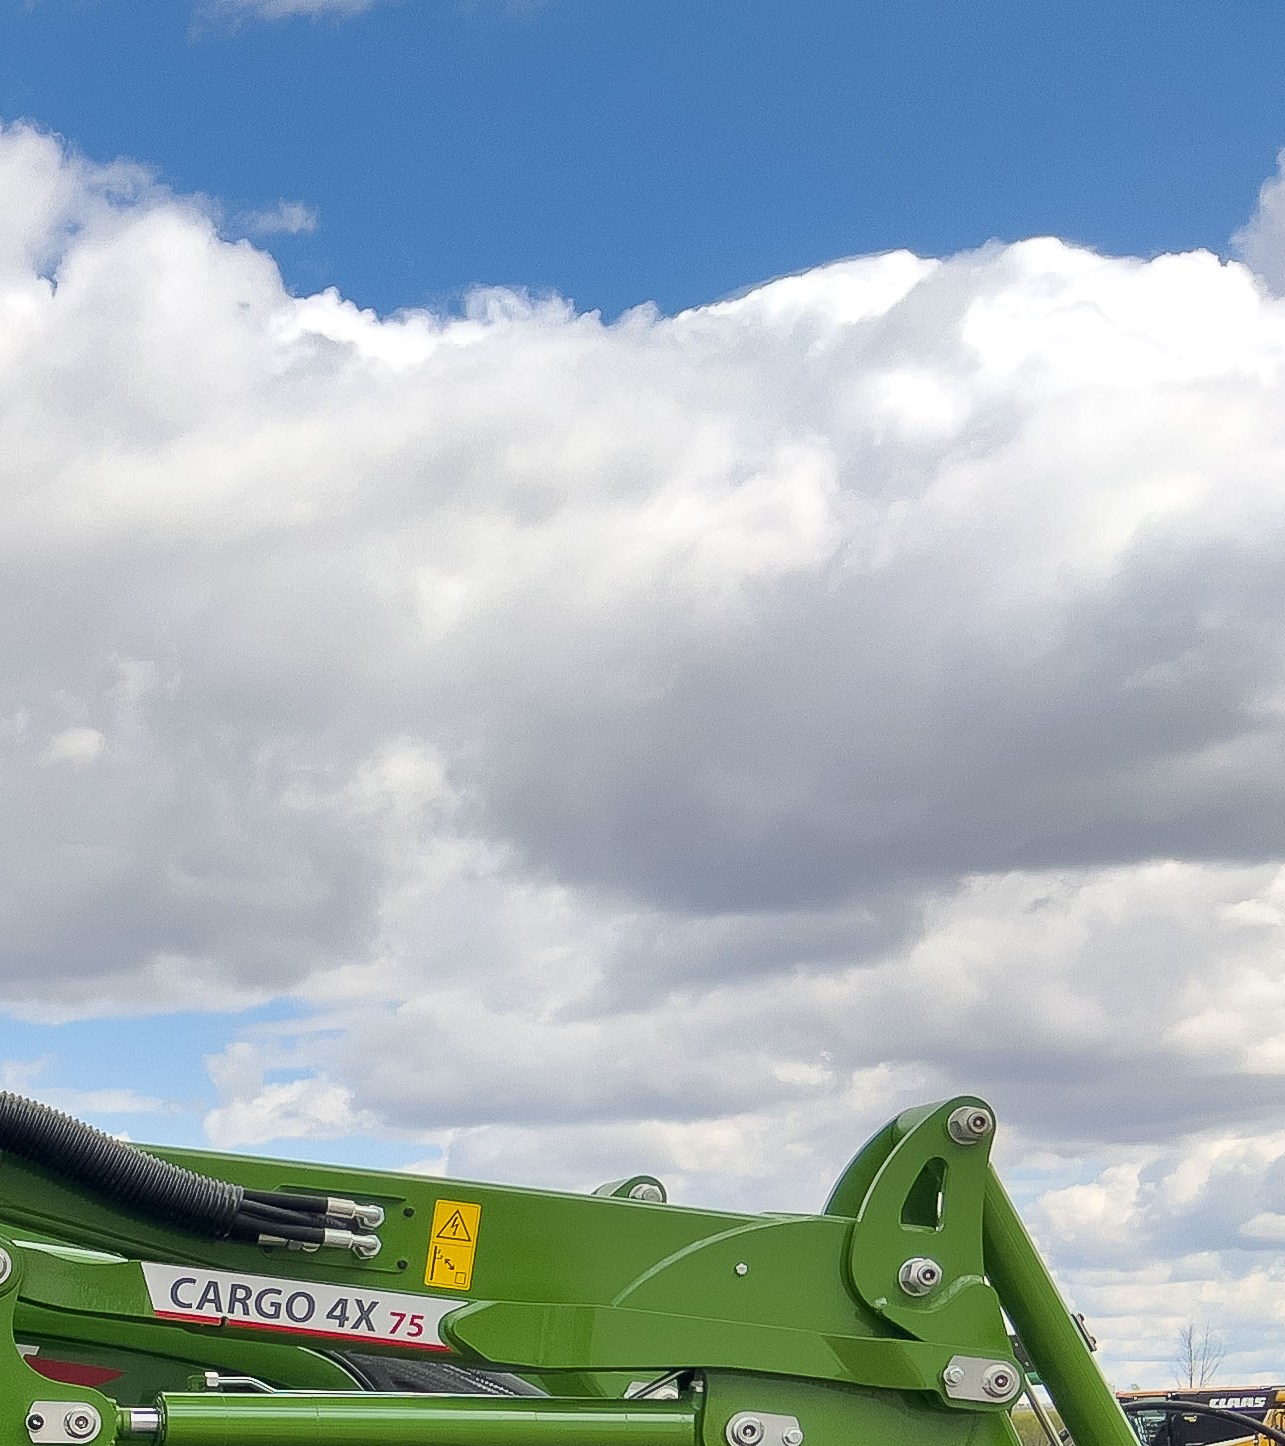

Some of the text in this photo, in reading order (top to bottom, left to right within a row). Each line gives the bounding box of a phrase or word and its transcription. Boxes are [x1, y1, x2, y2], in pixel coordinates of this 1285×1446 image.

[170, 1278, 425, 1337] CARGO 4X 75
[1209, 1396, 1267, 1408] CLAAS
